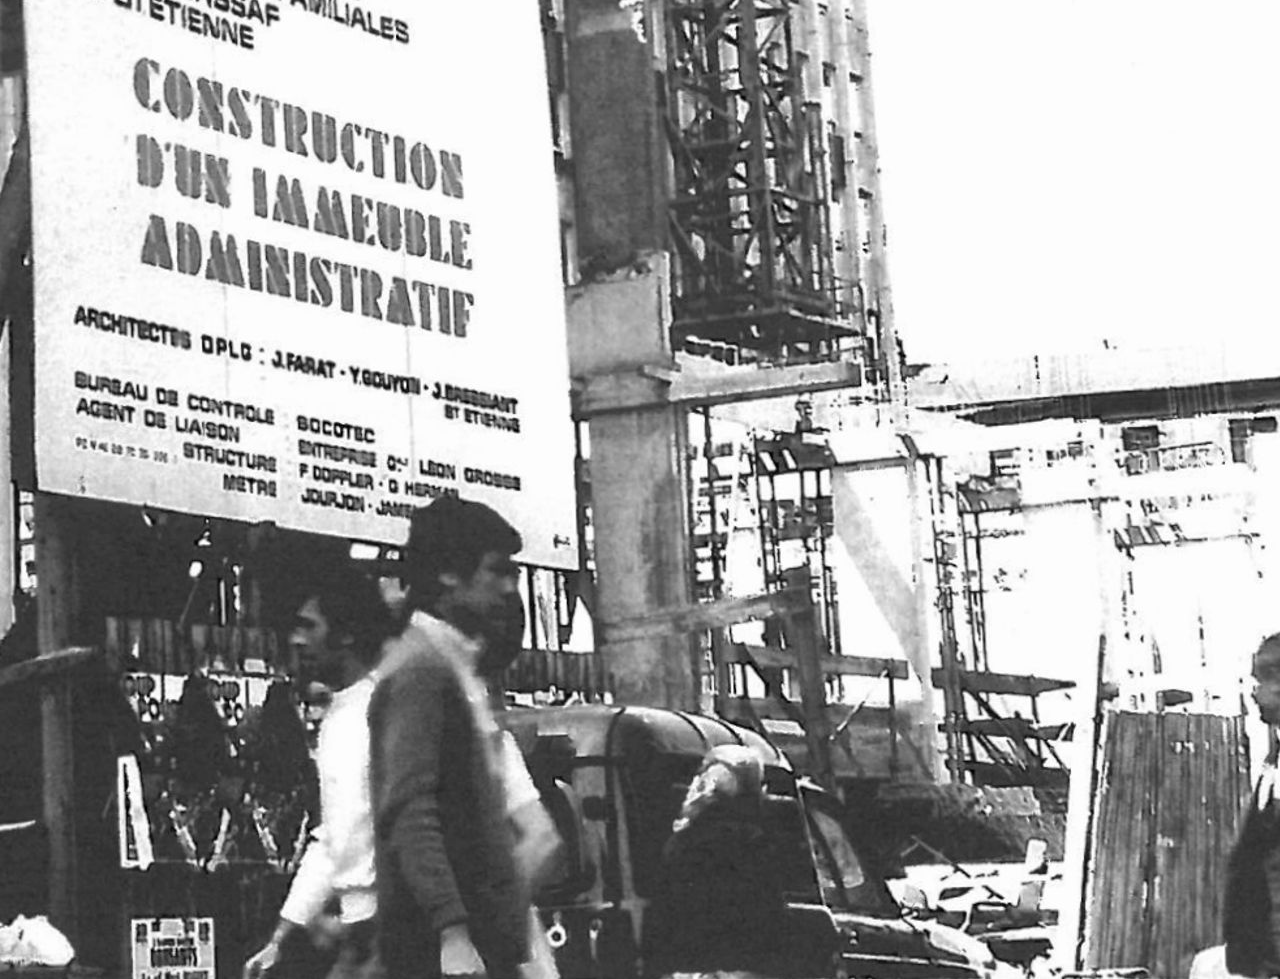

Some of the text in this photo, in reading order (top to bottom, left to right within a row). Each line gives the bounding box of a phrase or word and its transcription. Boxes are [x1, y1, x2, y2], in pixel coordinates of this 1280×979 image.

[133, 56, 464, 200] CONSTRUCTION
[136, 133, 473, 270] D'UN IMMEUBLE
[140, 213, 474, 338] ADMINISTRATIF
[74, 305, 192, 350] ARCHITECTES
[74, 370, 149, 401] BUREAU
[156, 385, 179, 407] DE
[187, 393, 275, 426] CONTROLE
[76, 397, 240, 444] AGENT DE LIAISON
[182, 441, 278, 473] STRUCTURE
[419, 459, 456, 481] LEON
[312, 464, 375, 491] DOPPLER
[223, 473, 278, 498] METRE
